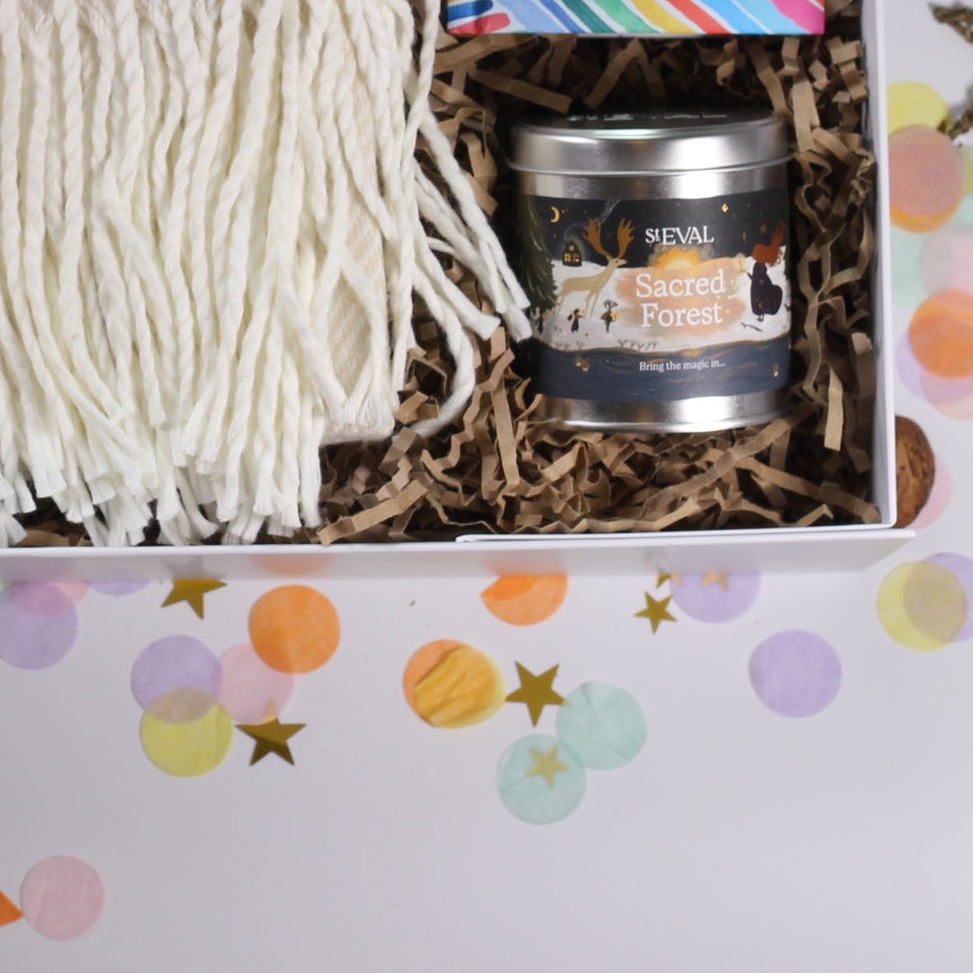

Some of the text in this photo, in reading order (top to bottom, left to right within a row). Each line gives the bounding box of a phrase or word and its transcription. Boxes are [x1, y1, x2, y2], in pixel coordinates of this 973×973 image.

[635, 268, 726, 298] Sacred
[640, 302, 724, 327] Forest
[639, 361, 665, 373] Bring
[666, 360, 682, 371] the
[683, 359, 709, 371] magic
